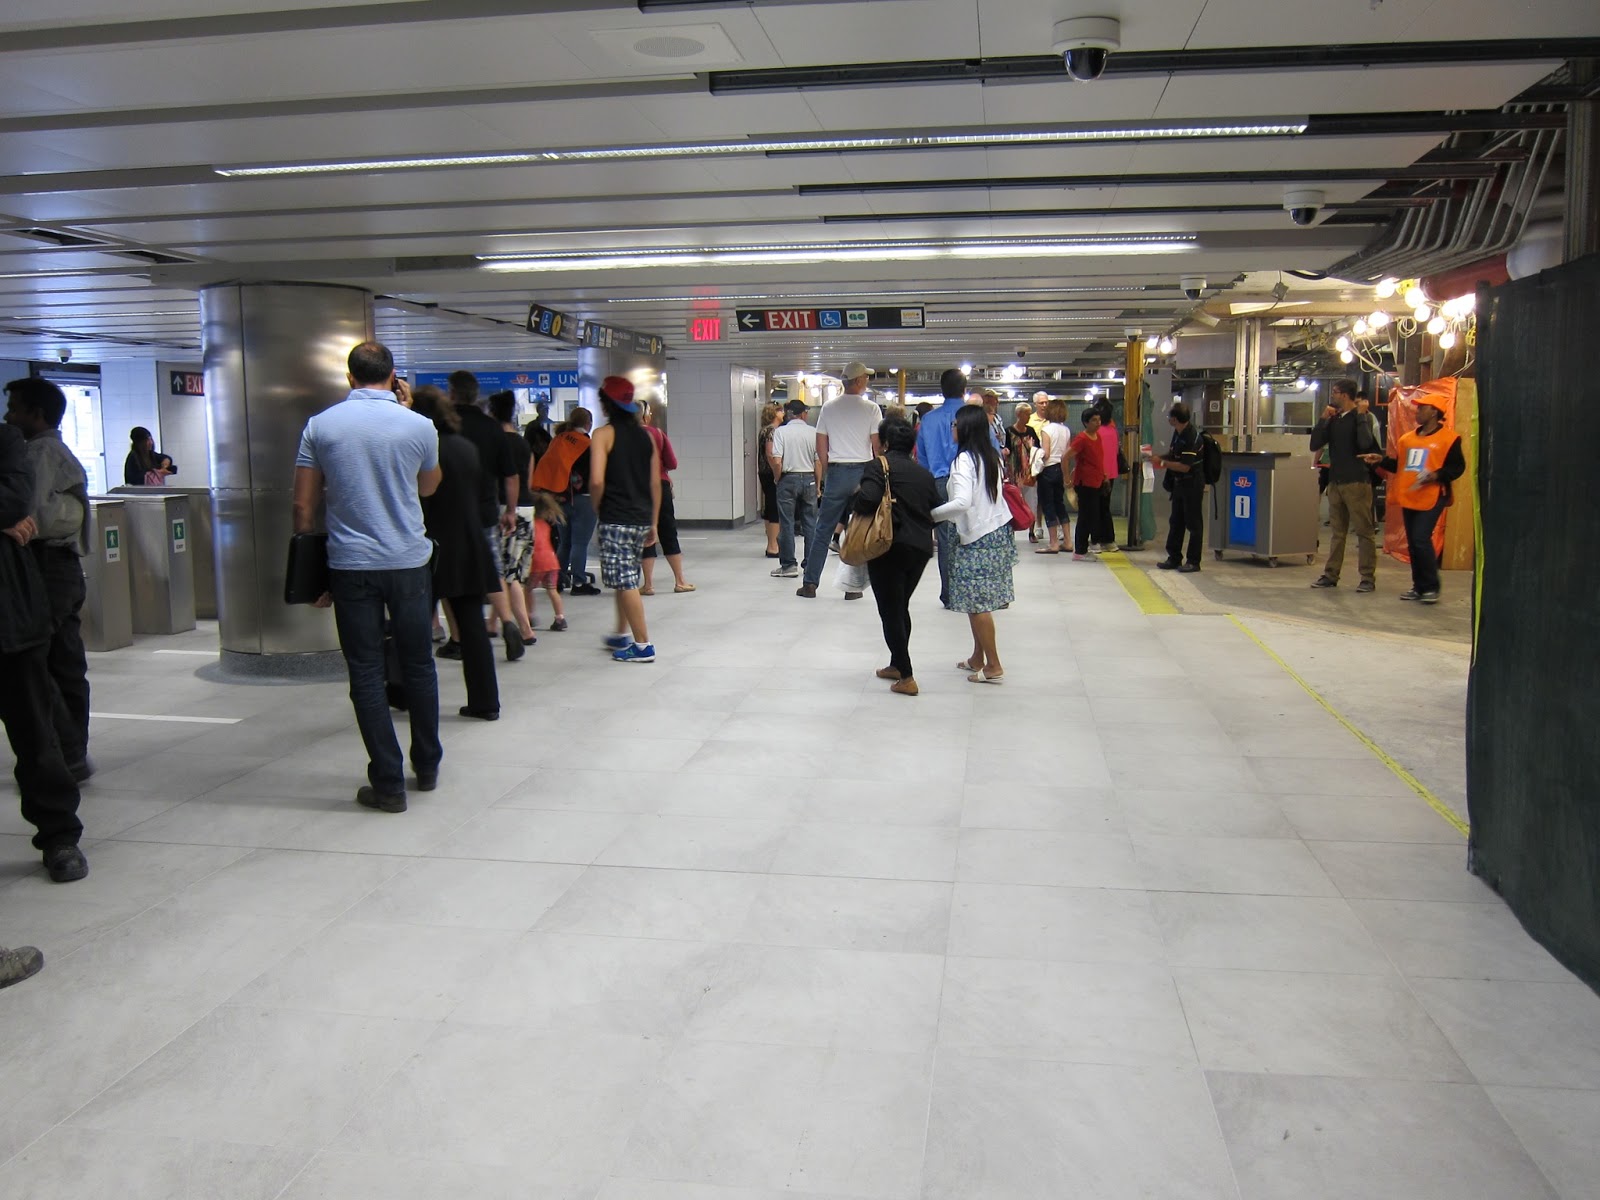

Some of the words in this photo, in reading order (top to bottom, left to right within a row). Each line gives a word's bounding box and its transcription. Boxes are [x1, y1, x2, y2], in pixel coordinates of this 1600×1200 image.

[768, 311, 811, 329] EXIT
[693, 319, 720, 341] EXIT
[185, 374, 203, 393] EXI
[558, 374, 578, 385] UN
